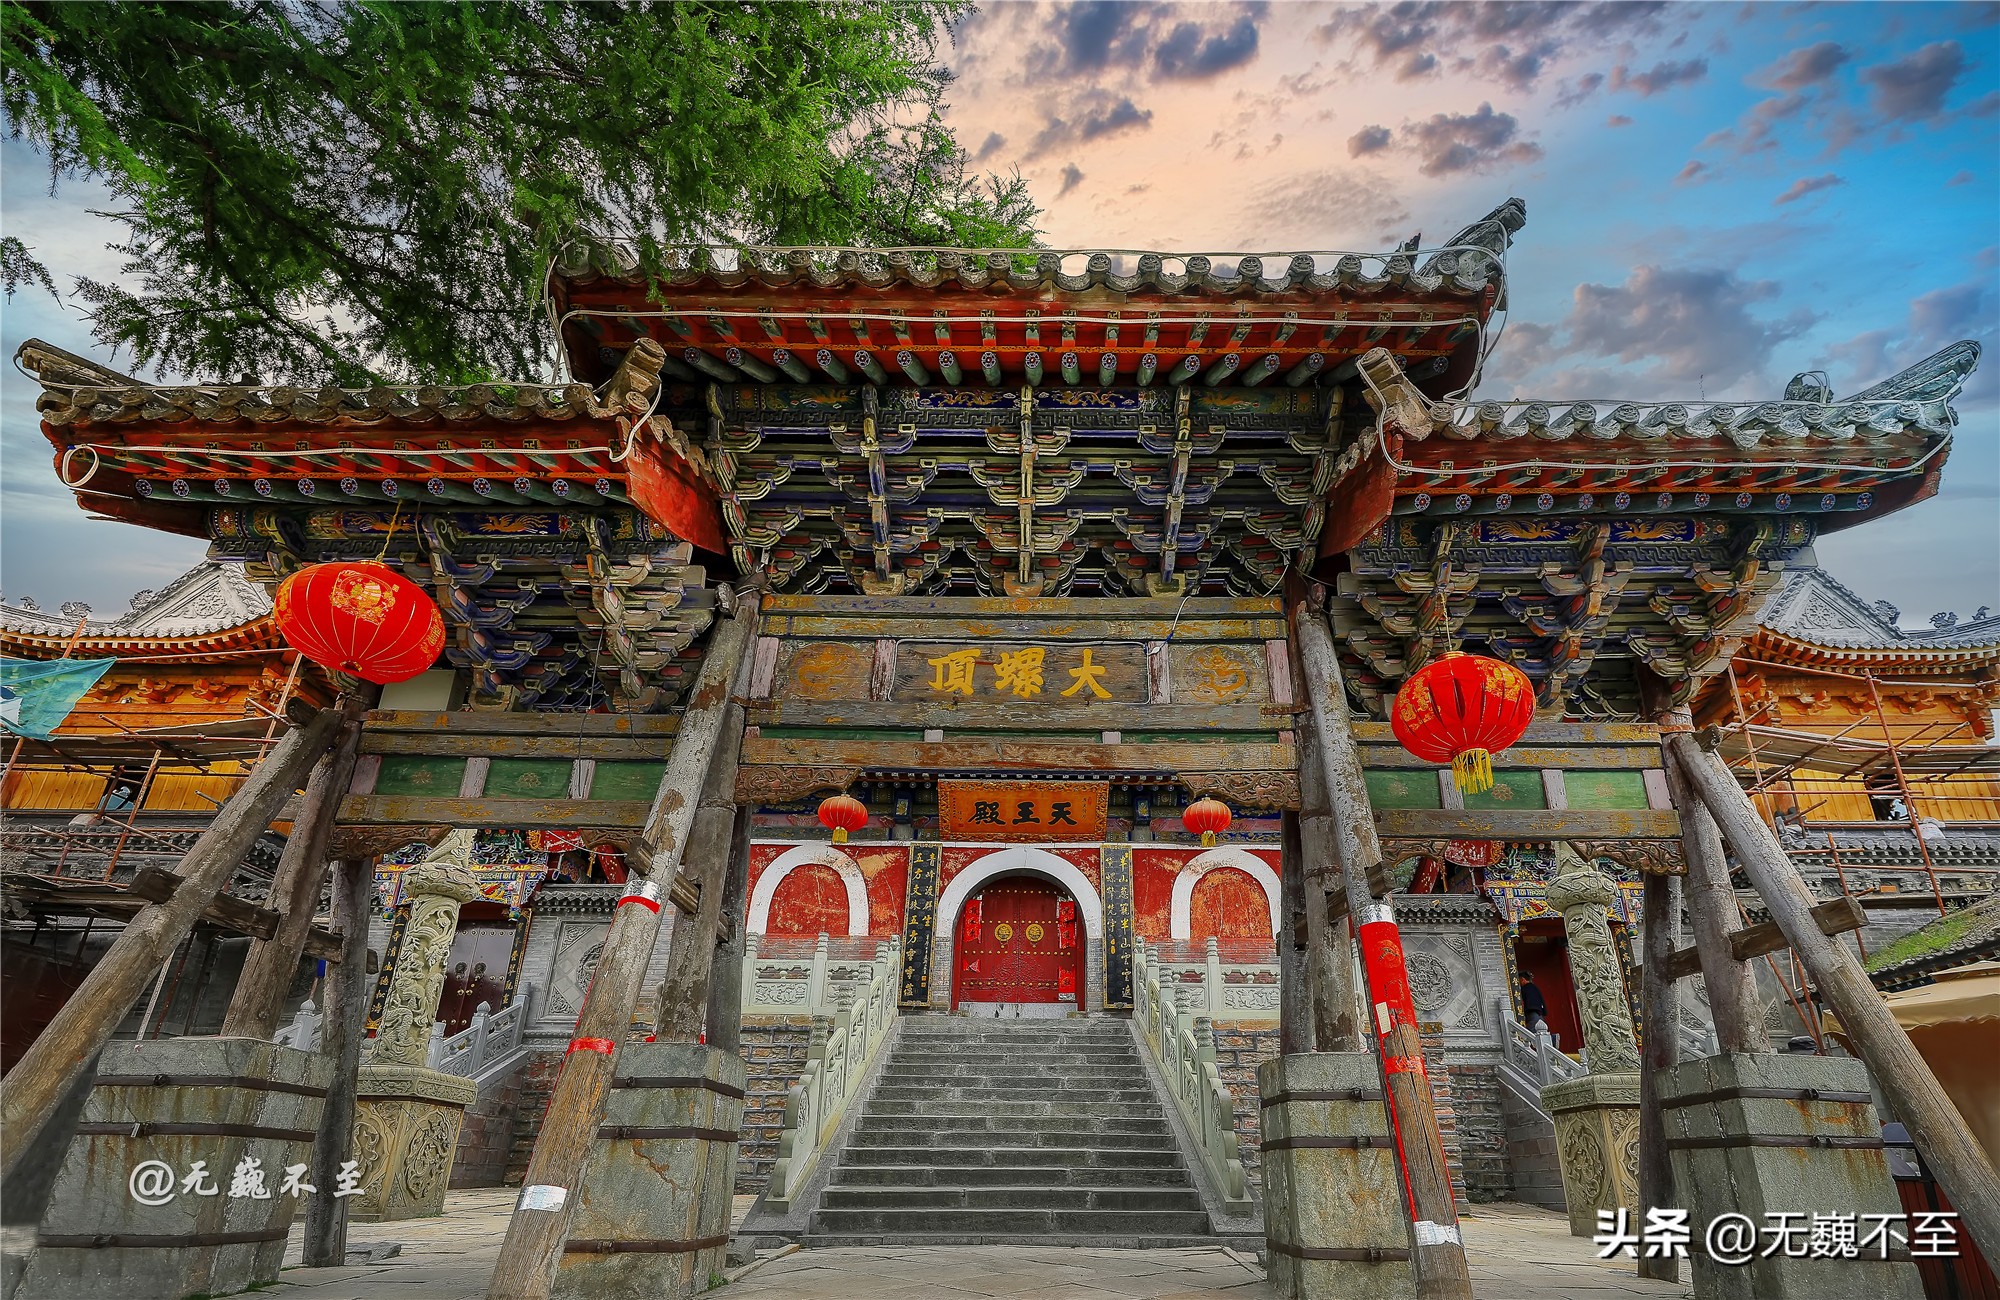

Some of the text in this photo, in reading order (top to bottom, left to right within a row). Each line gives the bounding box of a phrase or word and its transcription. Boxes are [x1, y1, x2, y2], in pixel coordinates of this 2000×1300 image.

[927, 647, 1113, 699] 大螺頂
[968, 801, 1078, 825] 天王殿
